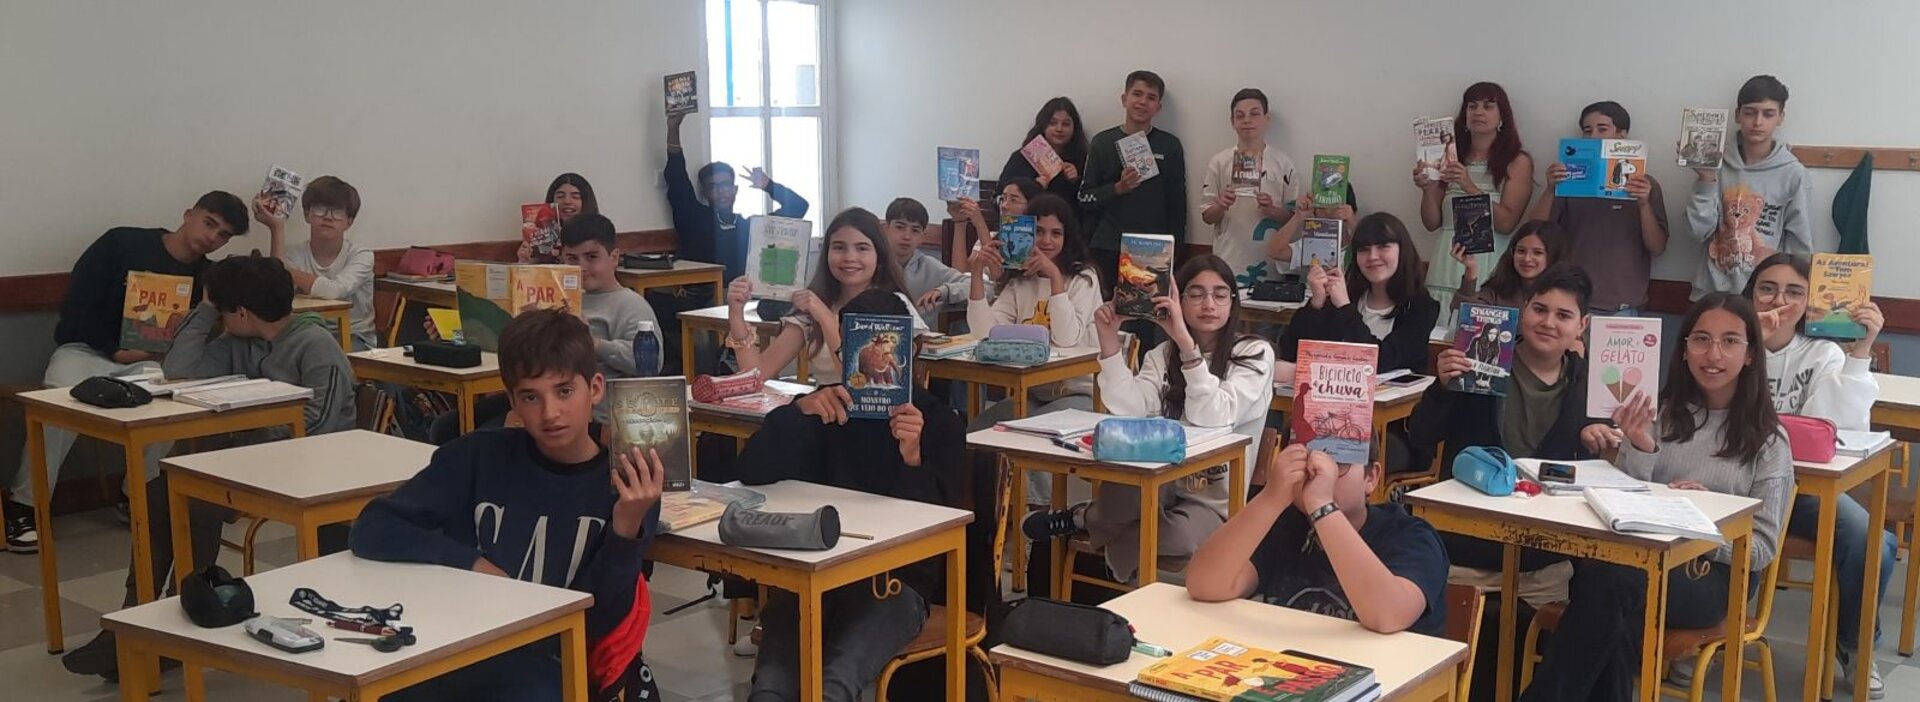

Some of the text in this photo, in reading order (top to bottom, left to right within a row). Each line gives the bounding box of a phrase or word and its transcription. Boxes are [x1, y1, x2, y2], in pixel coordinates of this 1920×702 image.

[516, 279, 524, 291] A
[139, 289, 167, 307] PAR
[526, 287, 555, 303] PAR
[1600, 348, 1645, 364] GELATO
[1319, 380, 1366, 398] chuva
[860, 396, 892, 404] MONSTRO
[739, 510, 795, 526] READY
[1171, 660, 1249, 680] A PAR
[1274, 664, 1347, 695] PASSO
